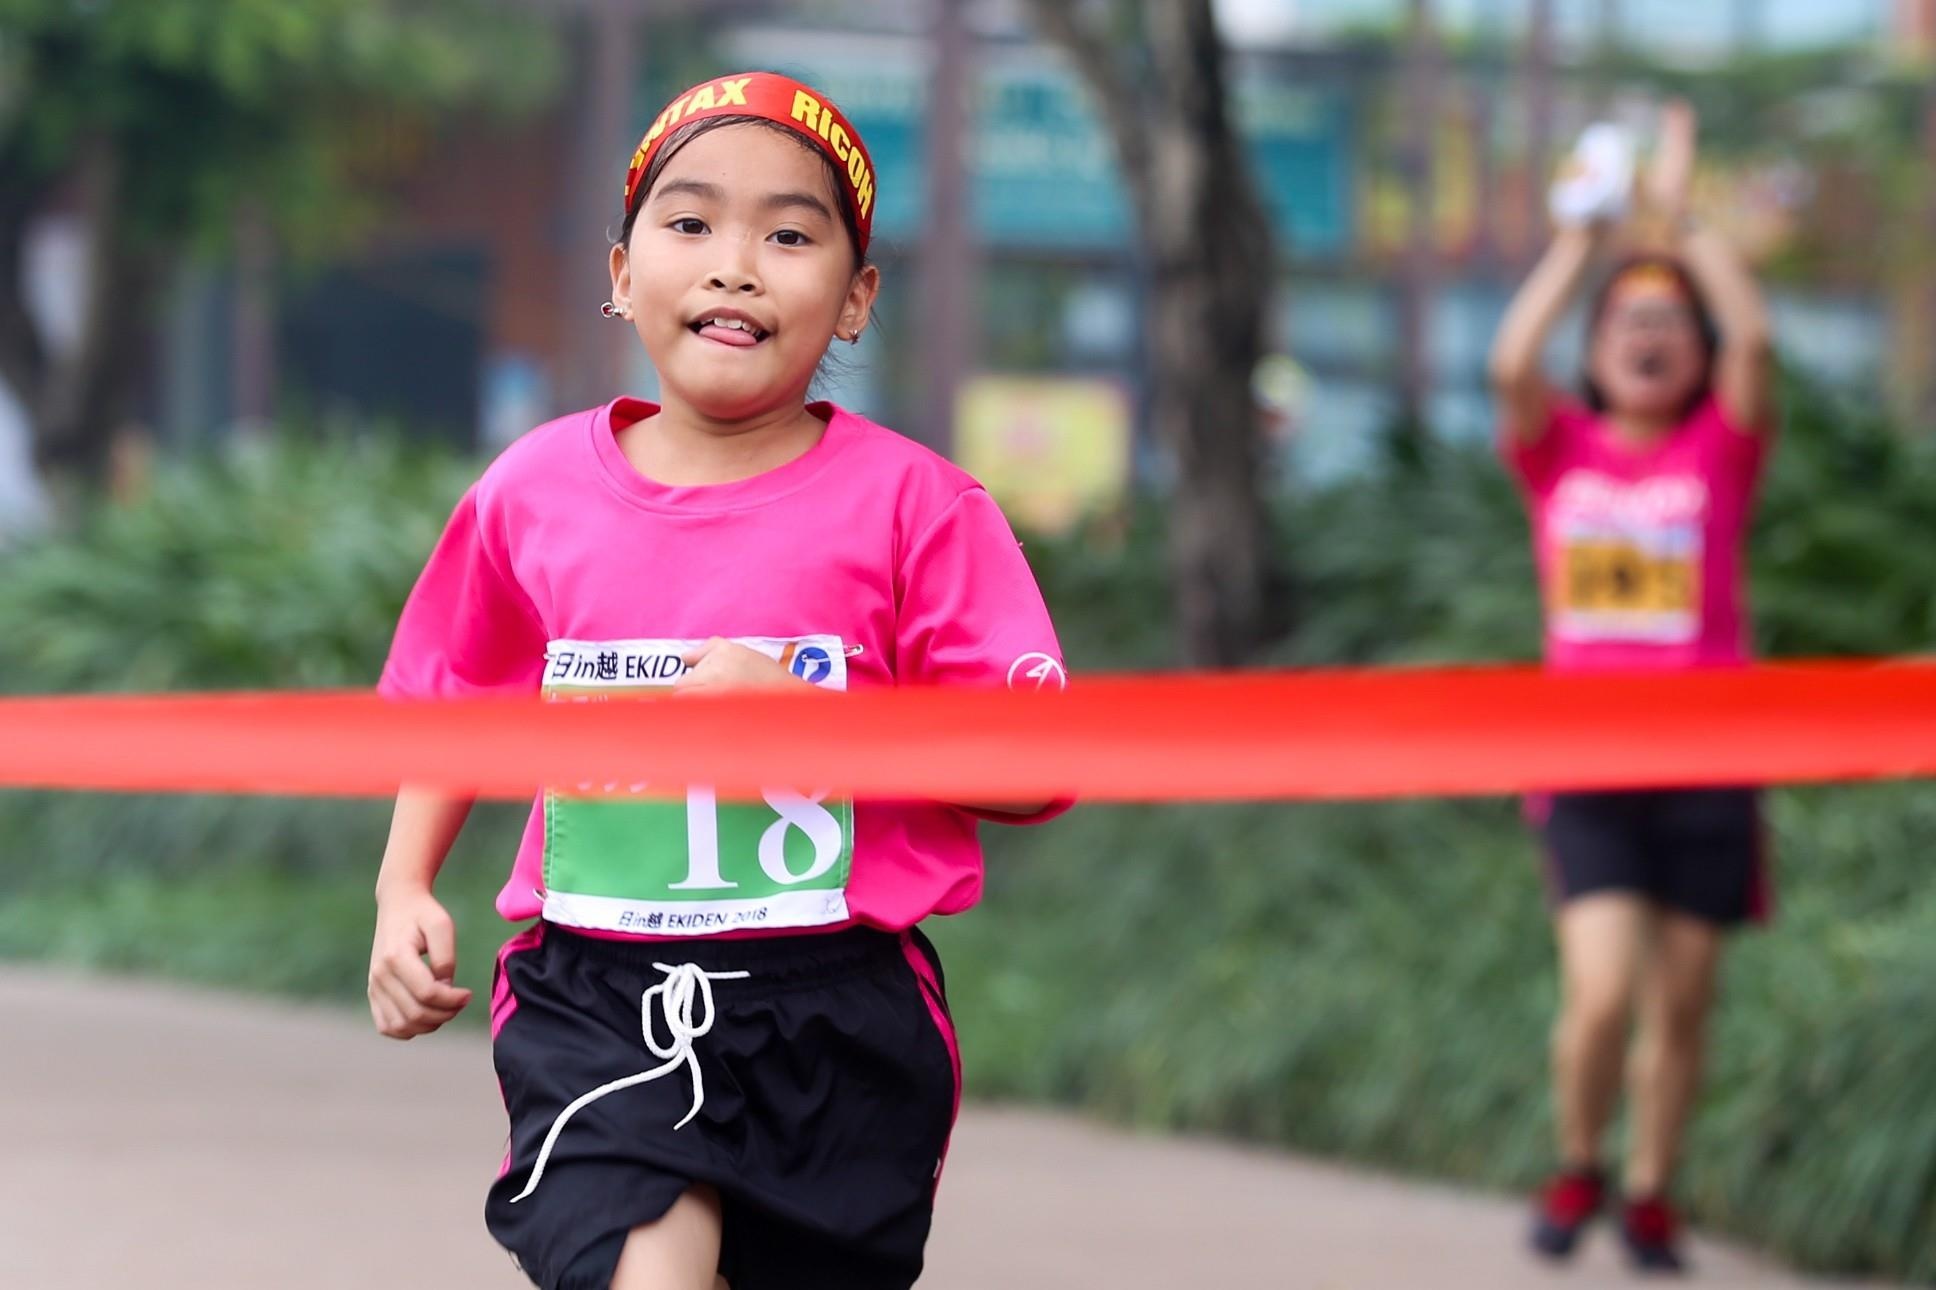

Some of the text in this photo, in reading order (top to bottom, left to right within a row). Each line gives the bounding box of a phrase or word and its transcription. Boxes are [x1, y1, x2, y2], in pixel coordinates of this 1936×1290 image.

[791, 89, 873, 219] RICOH
[668, 786, 842, 889] 18
[667, 911, 727, 928] EKIDEN
[731, 906, 768, 924] 2018
